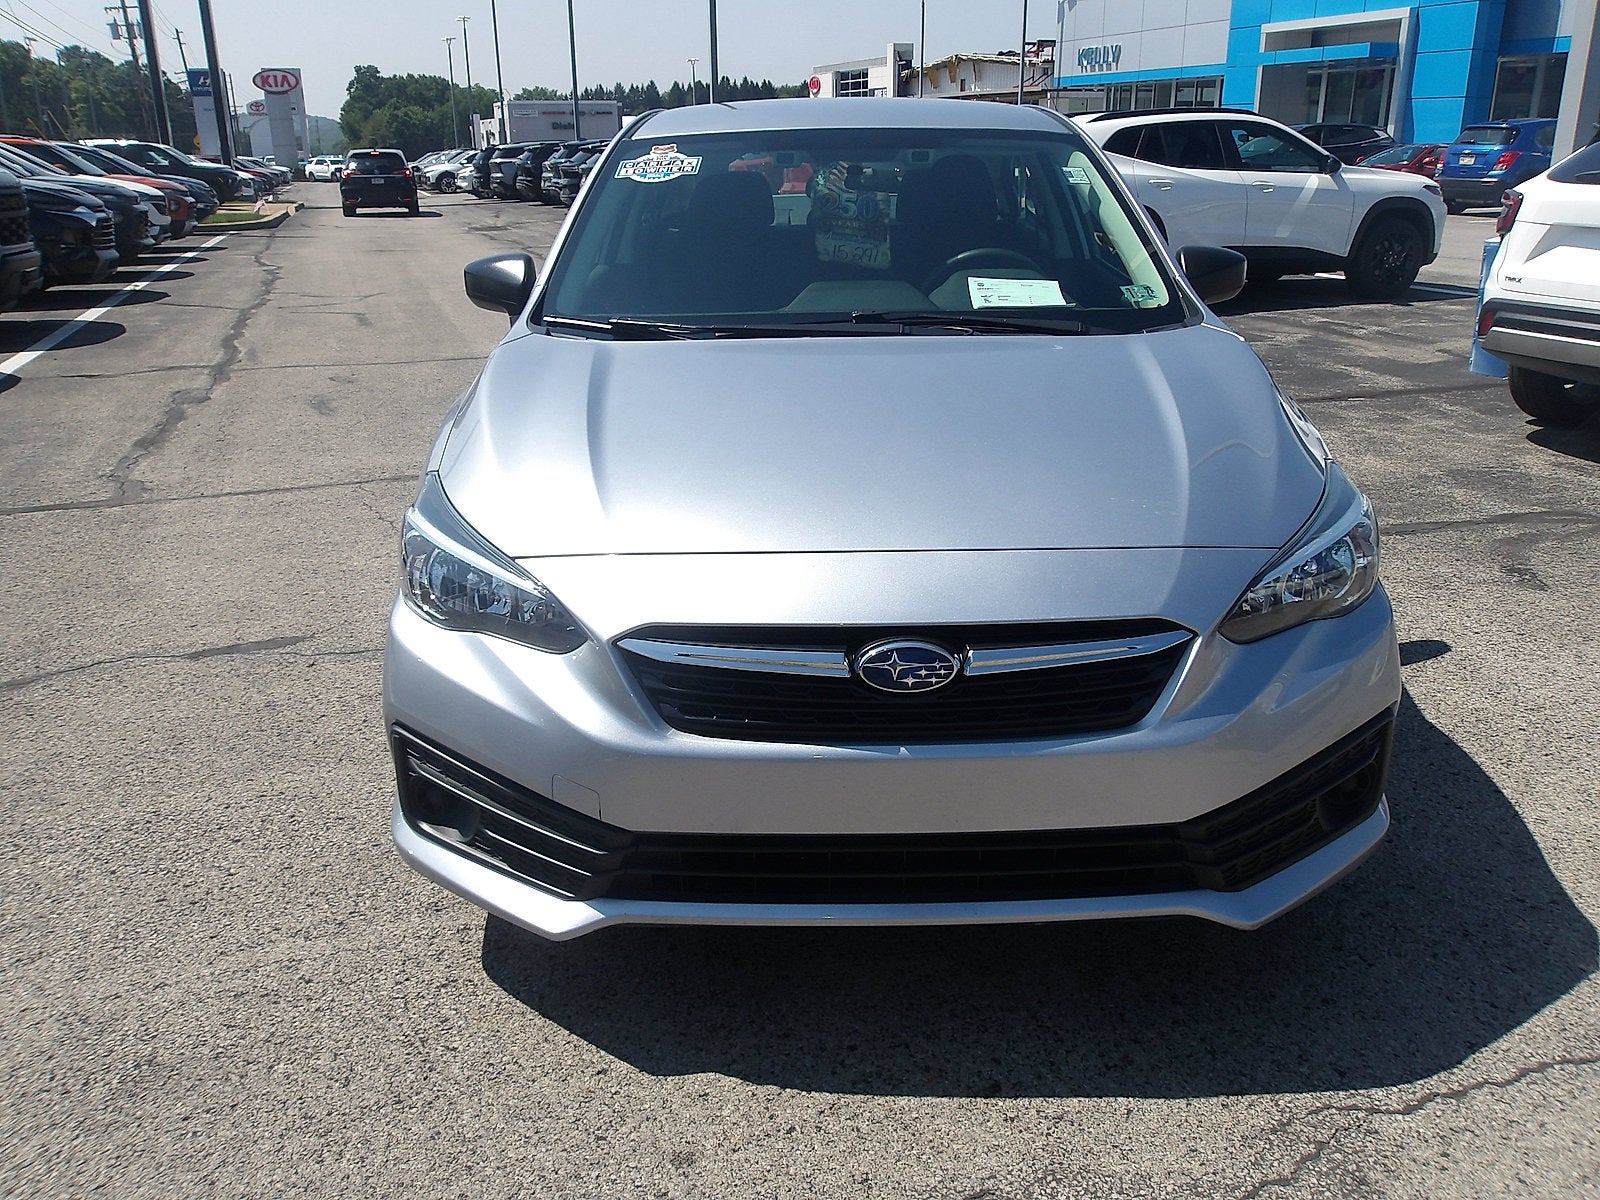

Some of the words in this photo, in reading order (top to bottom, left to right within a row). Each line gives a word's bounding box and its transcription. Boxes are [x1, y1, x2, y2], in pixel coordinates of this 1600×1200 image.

[1077, 44, 1121, 67] KELLY
[260, 74, 292, 88] KIA
[634, 165, 695, 175] OWNER
